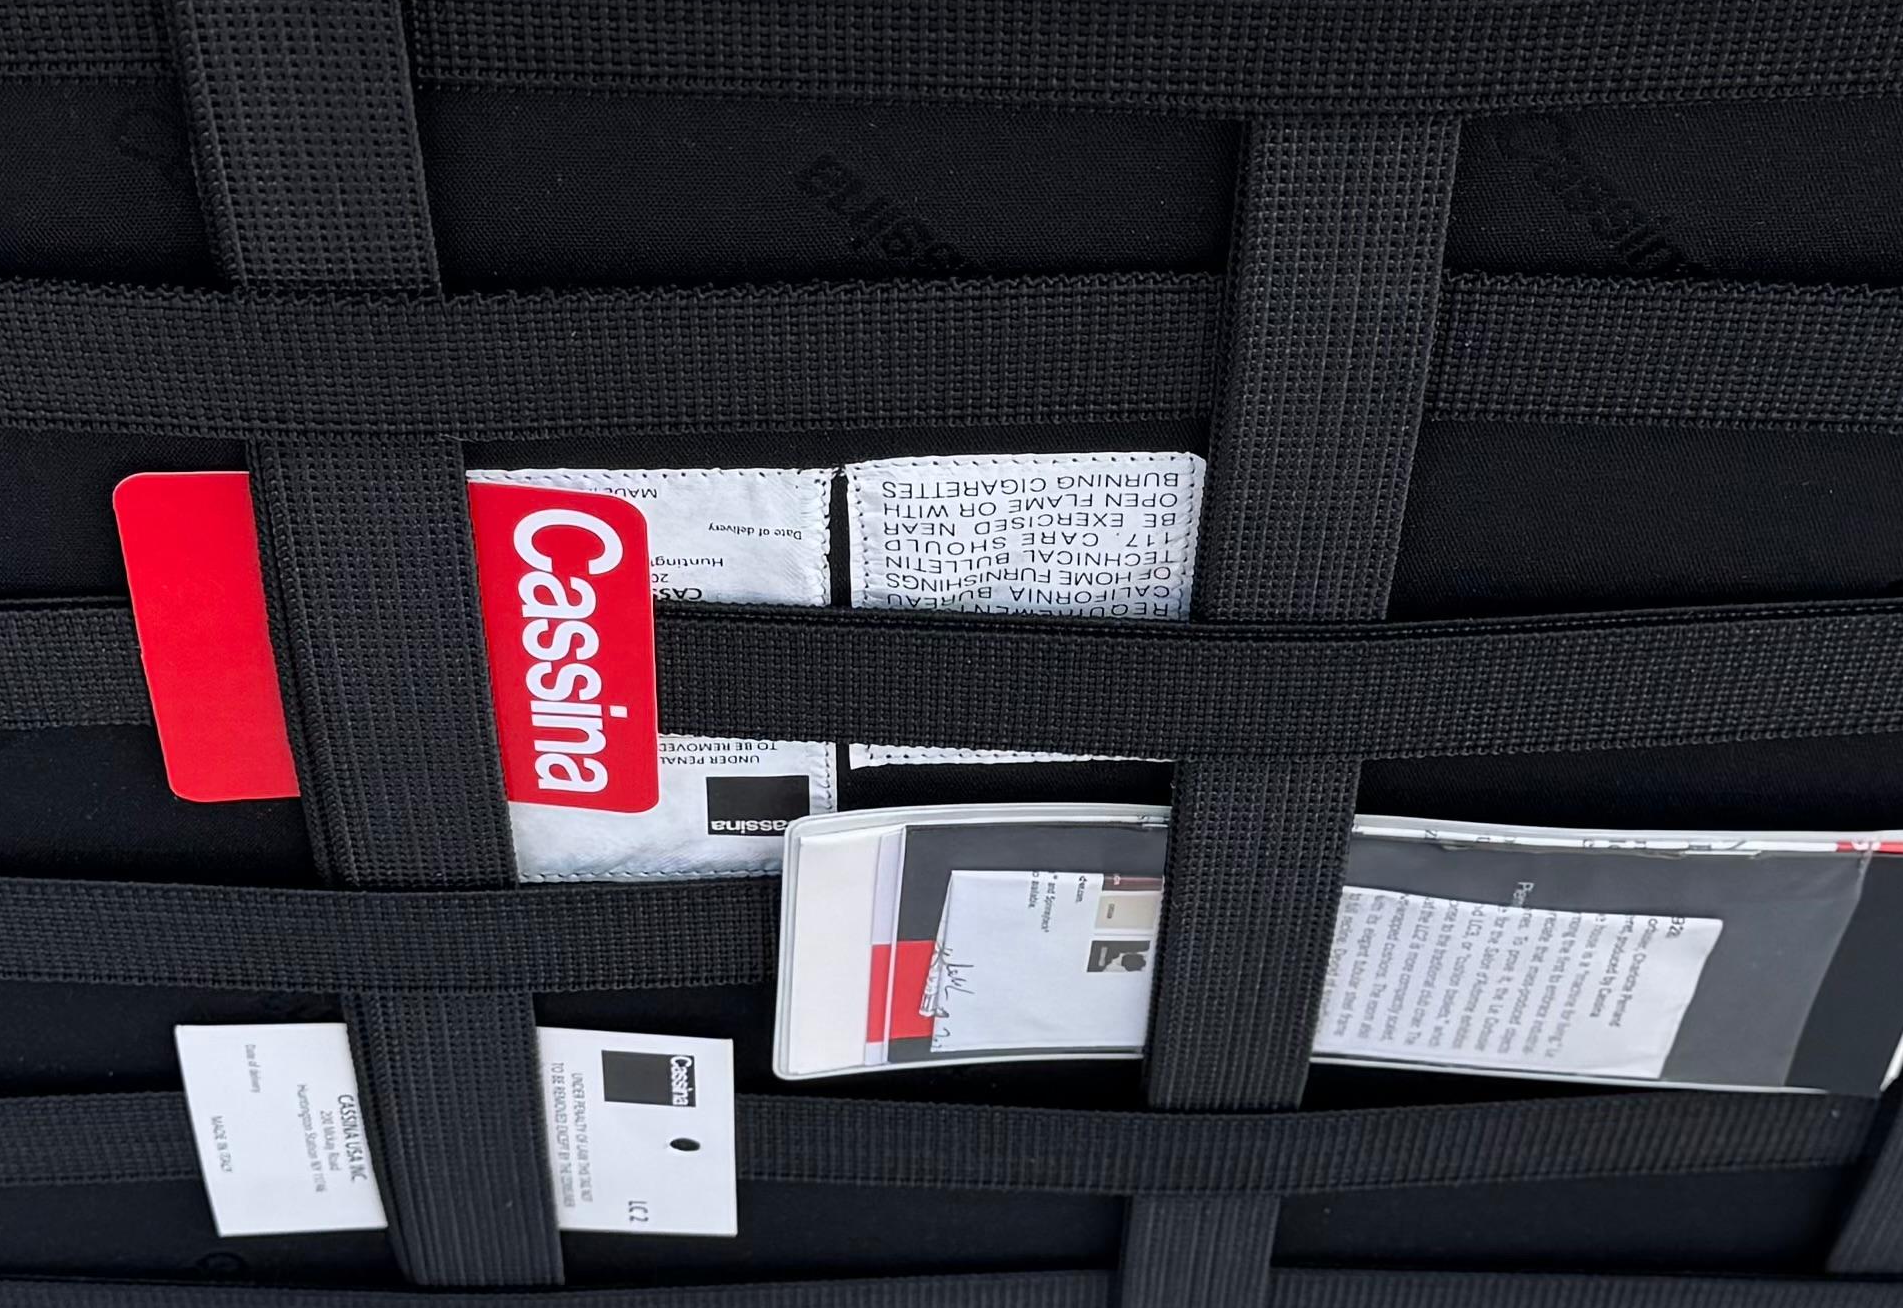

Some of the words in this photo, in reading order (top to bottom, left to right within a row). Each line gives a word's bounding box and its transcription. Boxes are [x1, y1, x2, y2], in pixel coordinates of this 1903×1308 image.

[1494, 111, 1694, 273] Cassin
[796, 152, 979, 275] ssina
[882, 477, 1047, 499] CIGARETTES
[1058, 473, 1178, 490] BURNING
[960, 502, 997, 517] OR
[1008, 493, 1093, 514] FLAME
[1105, 493, 1178, 509] OPEN
[883, 503, 949, 519] WITH
[707, 522, 756, 536] delivery
[974, 513, 1124, 536] EXERCISED
[1143, 513, 1177, 528] BE
[758, 527, 771, 538] of
[774, 528, 803, 541] Date
[884, 522, 956, 537] NEAR
[885, 537, 1007, 556] SHOULD
[1021, 532, 1099, 548] CARE
[886, 552, 1010, 574] BULLETIN
[1030, 550, 1174, 569] TECHNICAL
[885, 566, 1052, 592] FURNISHINGS
[1060, 570, 1134, 587] HOME
[1138, 566, 1173, 582] OF
[887, 586, 991, 607] BUREAU
[1009, 584, 1171, 605] CALIFORNIA
[513, 508, 628, 793] Cassina
[736, 741, 754, 751] BE
[757, 741, 778, 751] TO
[659, 755, 705, 765] PENAL
[710, 755, 760, 765] UNDER
[711, 819, 789, 834] assina
[670, 1056, 695, 1106] Cassina
[337, 1093, 360, 1141] CASSINA
[345, 1141, 364, 1163] USA
